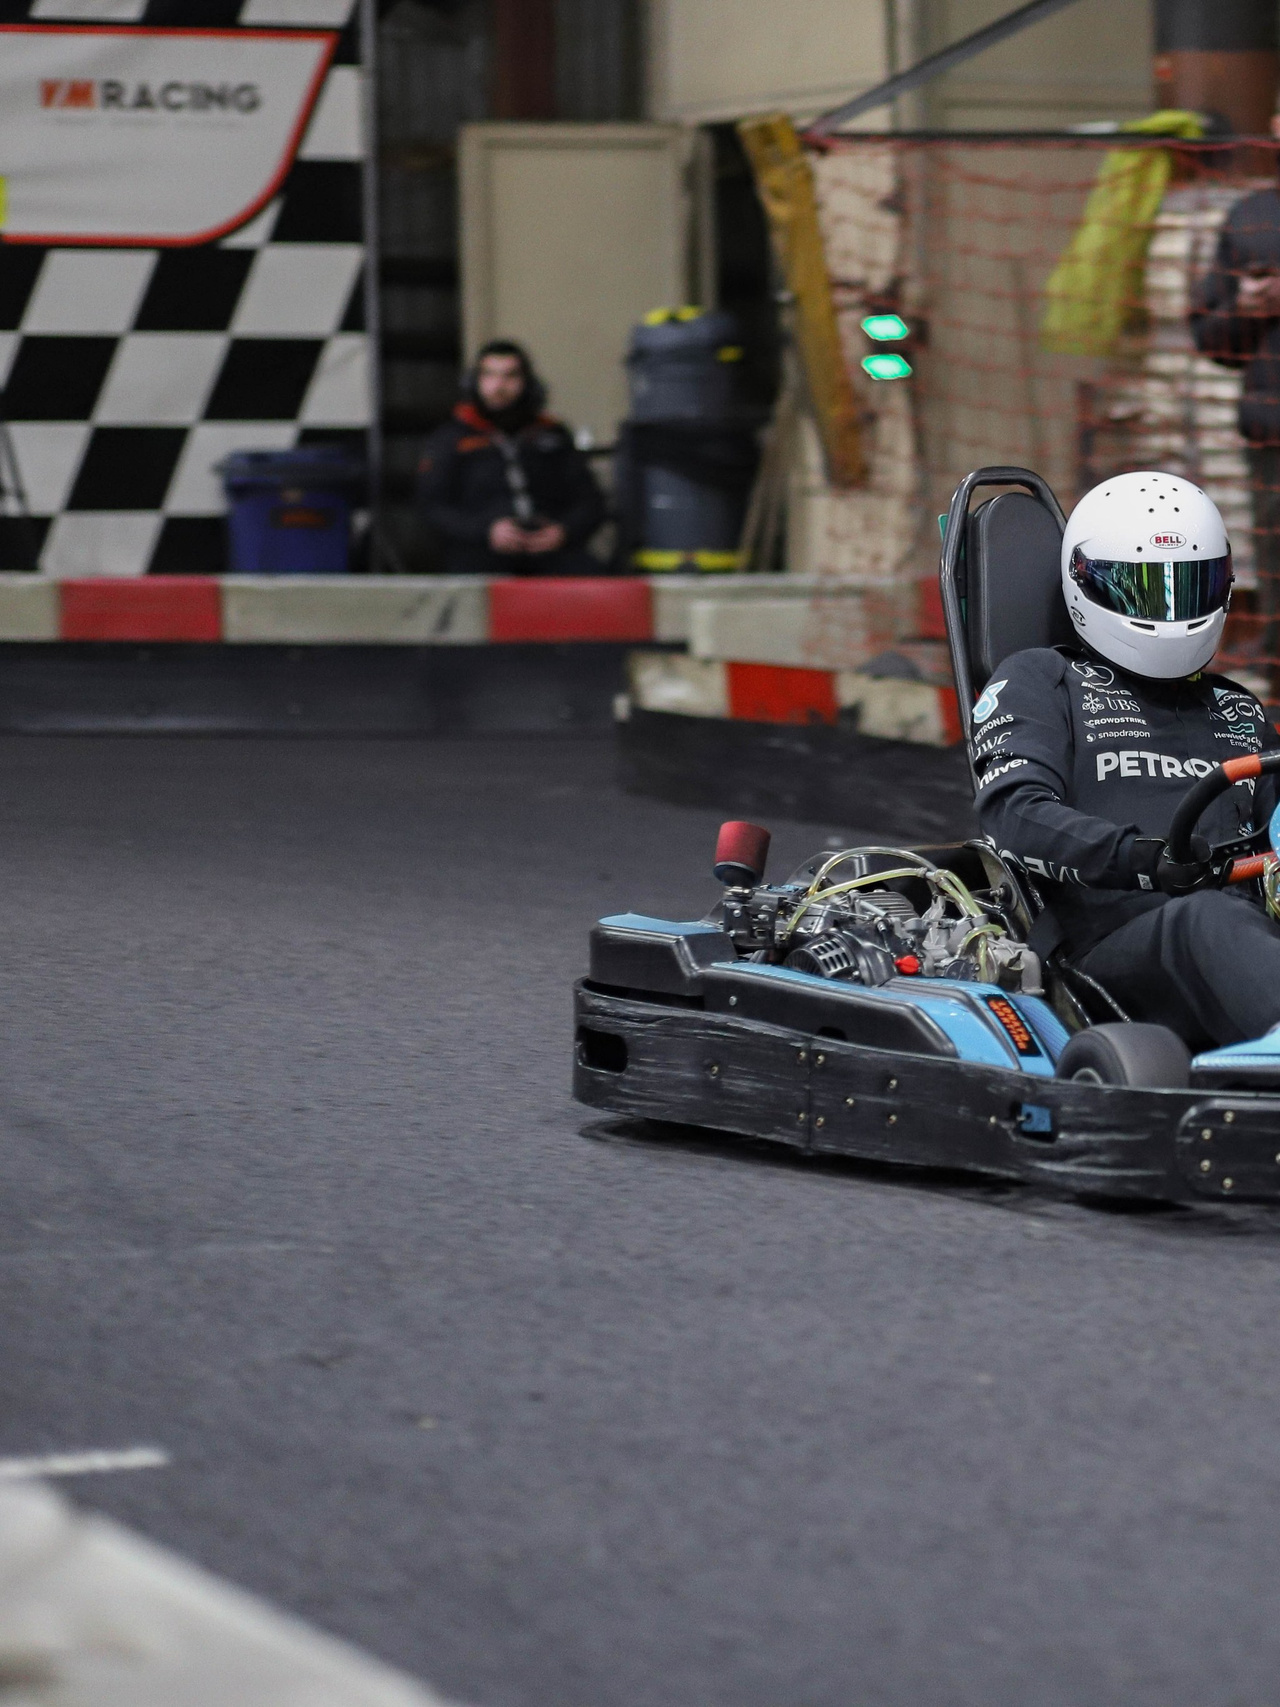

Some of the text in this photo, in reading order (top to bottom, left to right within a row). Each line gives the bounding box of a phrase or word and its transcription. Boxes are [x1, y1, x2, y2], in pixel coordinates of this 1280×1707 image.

[1155, 536, 1181, 544] BELL
[1105, 697, 1141, 712] UBS
[1088, 717, 1147, 726] CROWDSTRIKE
[1098, 729, 1151, 740] snapdragon
